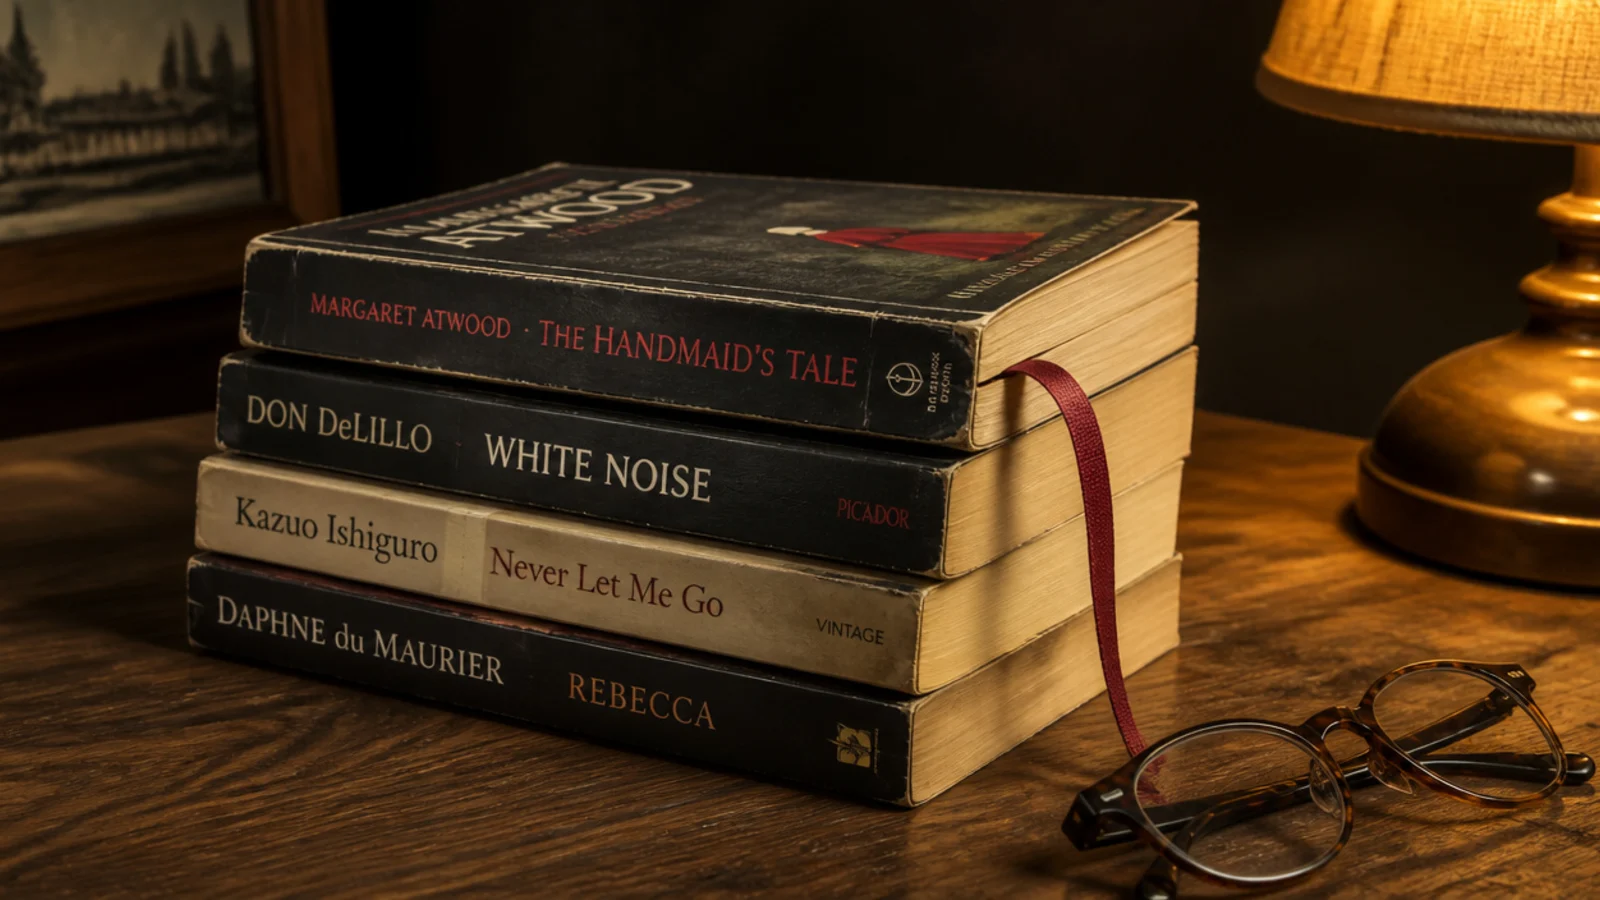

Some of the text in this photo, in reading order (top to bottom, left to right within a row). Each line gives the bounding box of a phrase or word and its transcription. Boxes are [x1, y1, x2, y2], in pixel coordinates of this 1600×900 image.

[421, 178, 693, 249] ATWOOD
[310, 292, 858, 388] MARGARET ATWOOD THE HANDMAID'S TALE
[247, 394, 432, 453] DON DeLILLO
[484, 433, 712, 503] WHITE NOISE
[235, 496, 438, 564] Kazuo Ishiguro
[837, 497, 911, 530] PICADOR
[489, 546, 724, 618] Never Let Me Go
[217, 595, 504, 685] DAPHNE du MAURIER
[816, 618, 885, 646] VINTAGE
[568, 672, 716, 731] REBECCA
